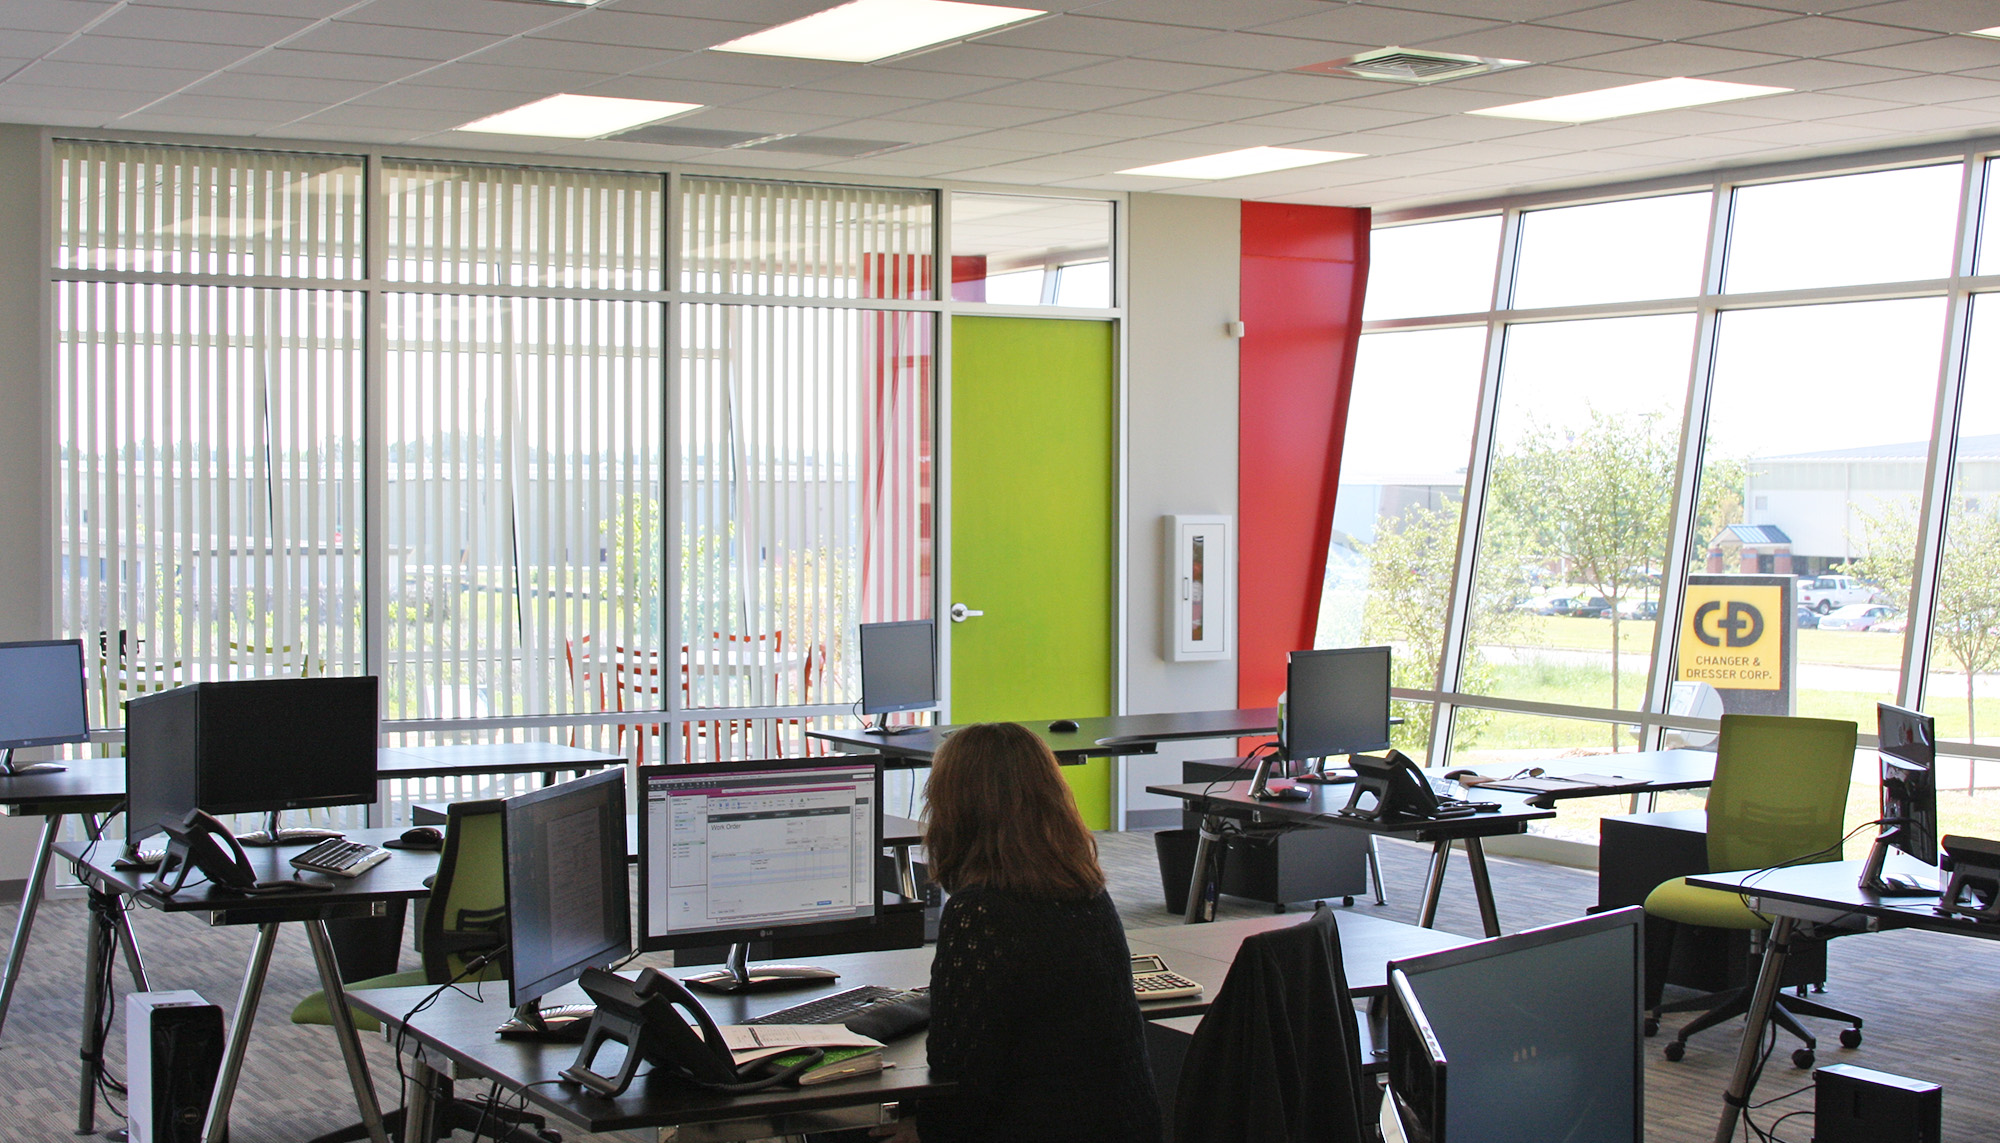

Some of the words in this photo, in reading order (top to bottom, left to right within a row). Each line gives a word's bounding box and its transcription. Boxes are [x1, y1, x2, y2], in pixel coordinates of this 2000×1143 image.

[1695, 656, 1750, 666] CHANGER
[1752, 657, 1761, 666] &
[1686, 668, 1737, 679] DRESSER
[1739, 670, 1772, 680] CORP.
[726, 822, 741, 830] Order
